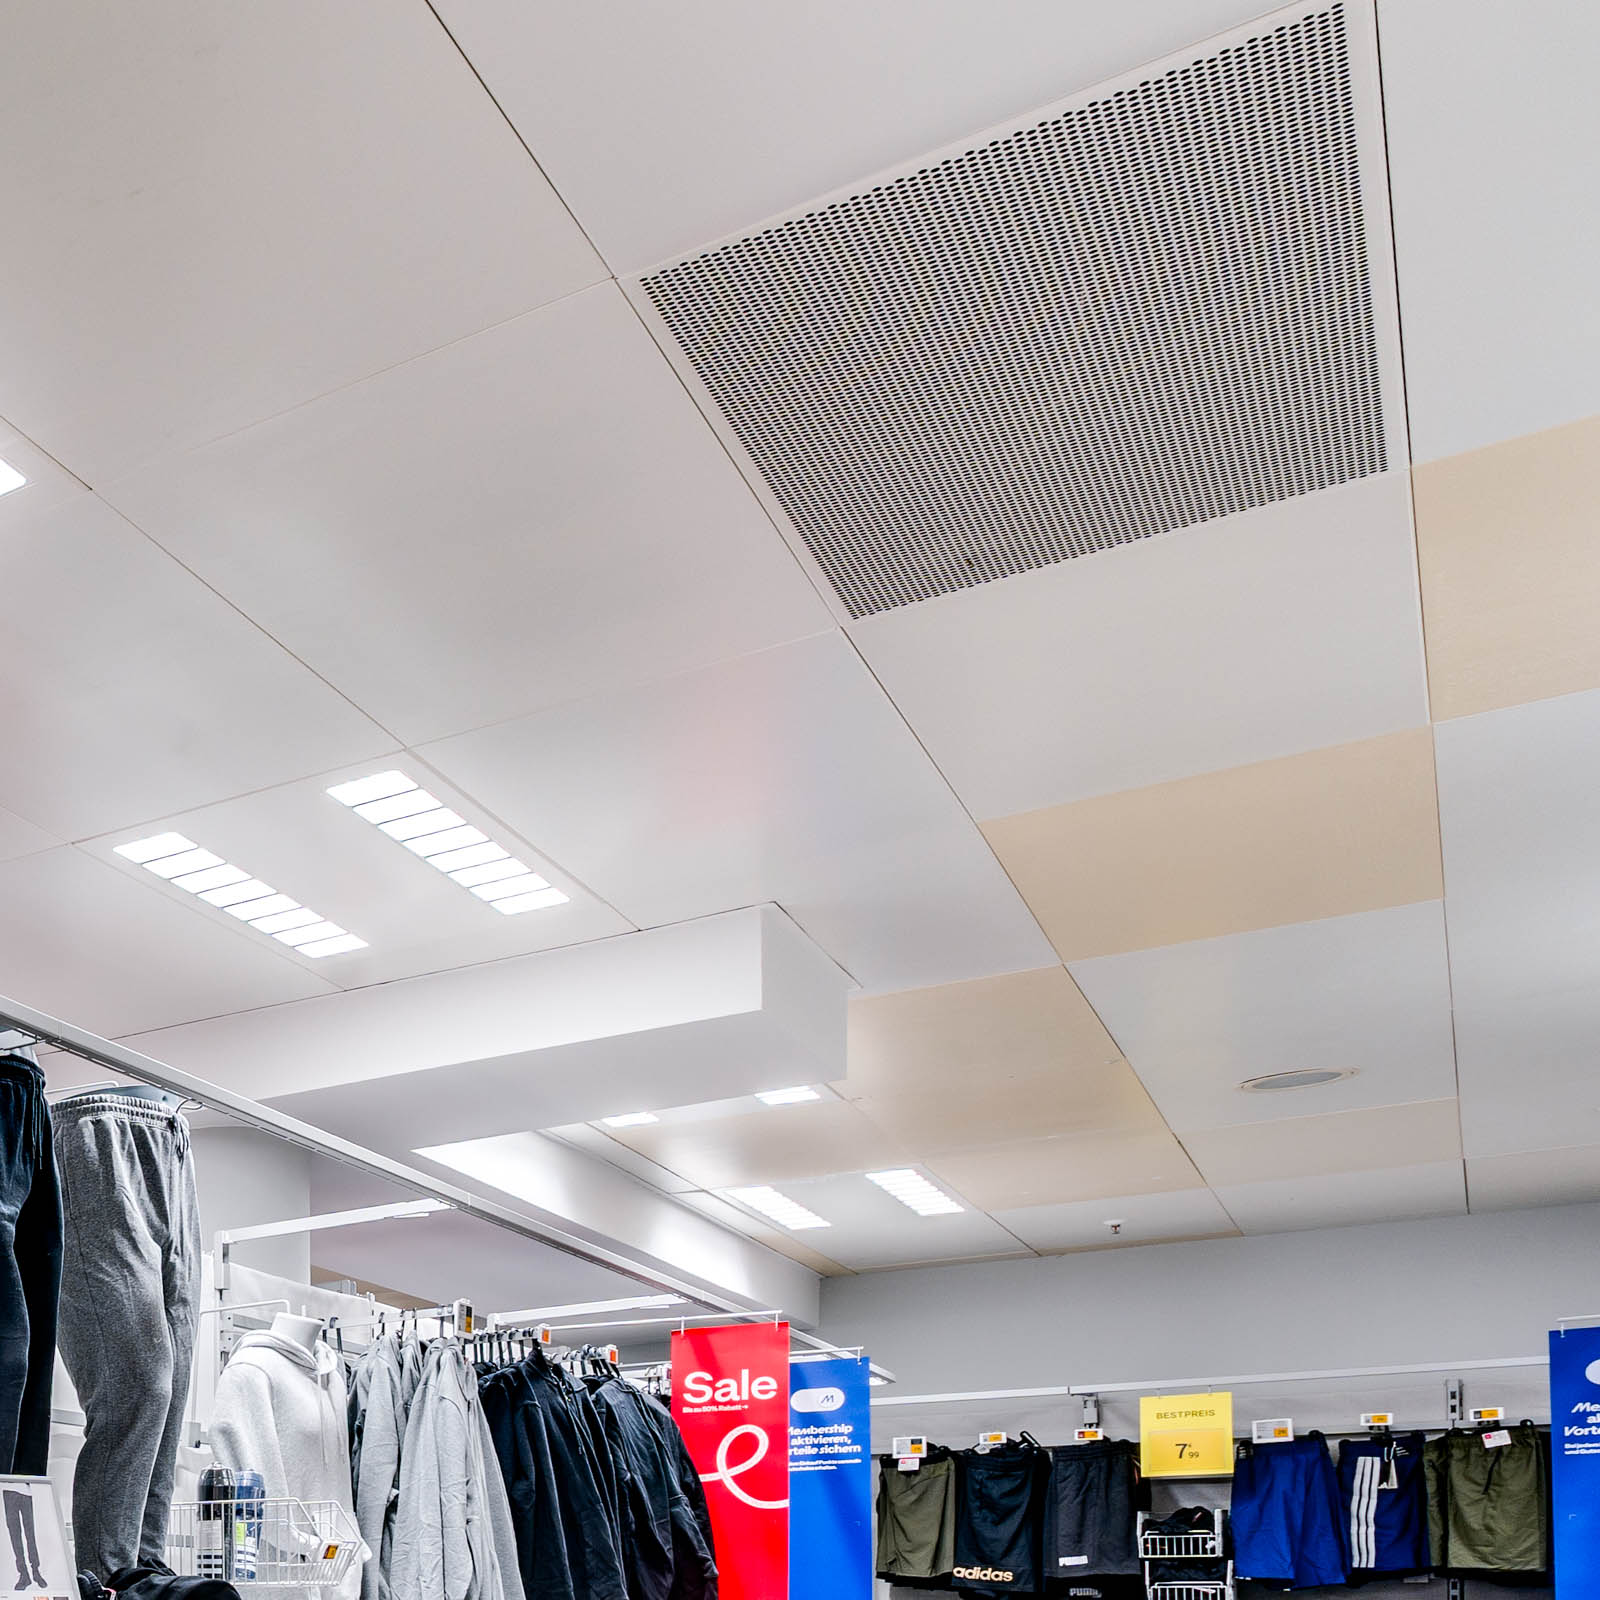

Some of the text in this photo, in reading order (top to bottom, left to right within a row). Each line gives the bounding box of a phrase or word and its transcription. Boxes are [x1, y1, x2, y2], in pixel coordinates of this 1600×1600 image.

[683, 1368, 778, 1404] Sale
[1156, 1409, 1216, 1420] BESTPREIS
[790, 1435, 852, 1445] aktivieren,
[789, 1446, 819, 1456] rteile
[1175, 1443, 1187, 1459] 7
[1187, 1451, 1200, 1459] 99
[953, 1567, 1013, 1582] adidas
